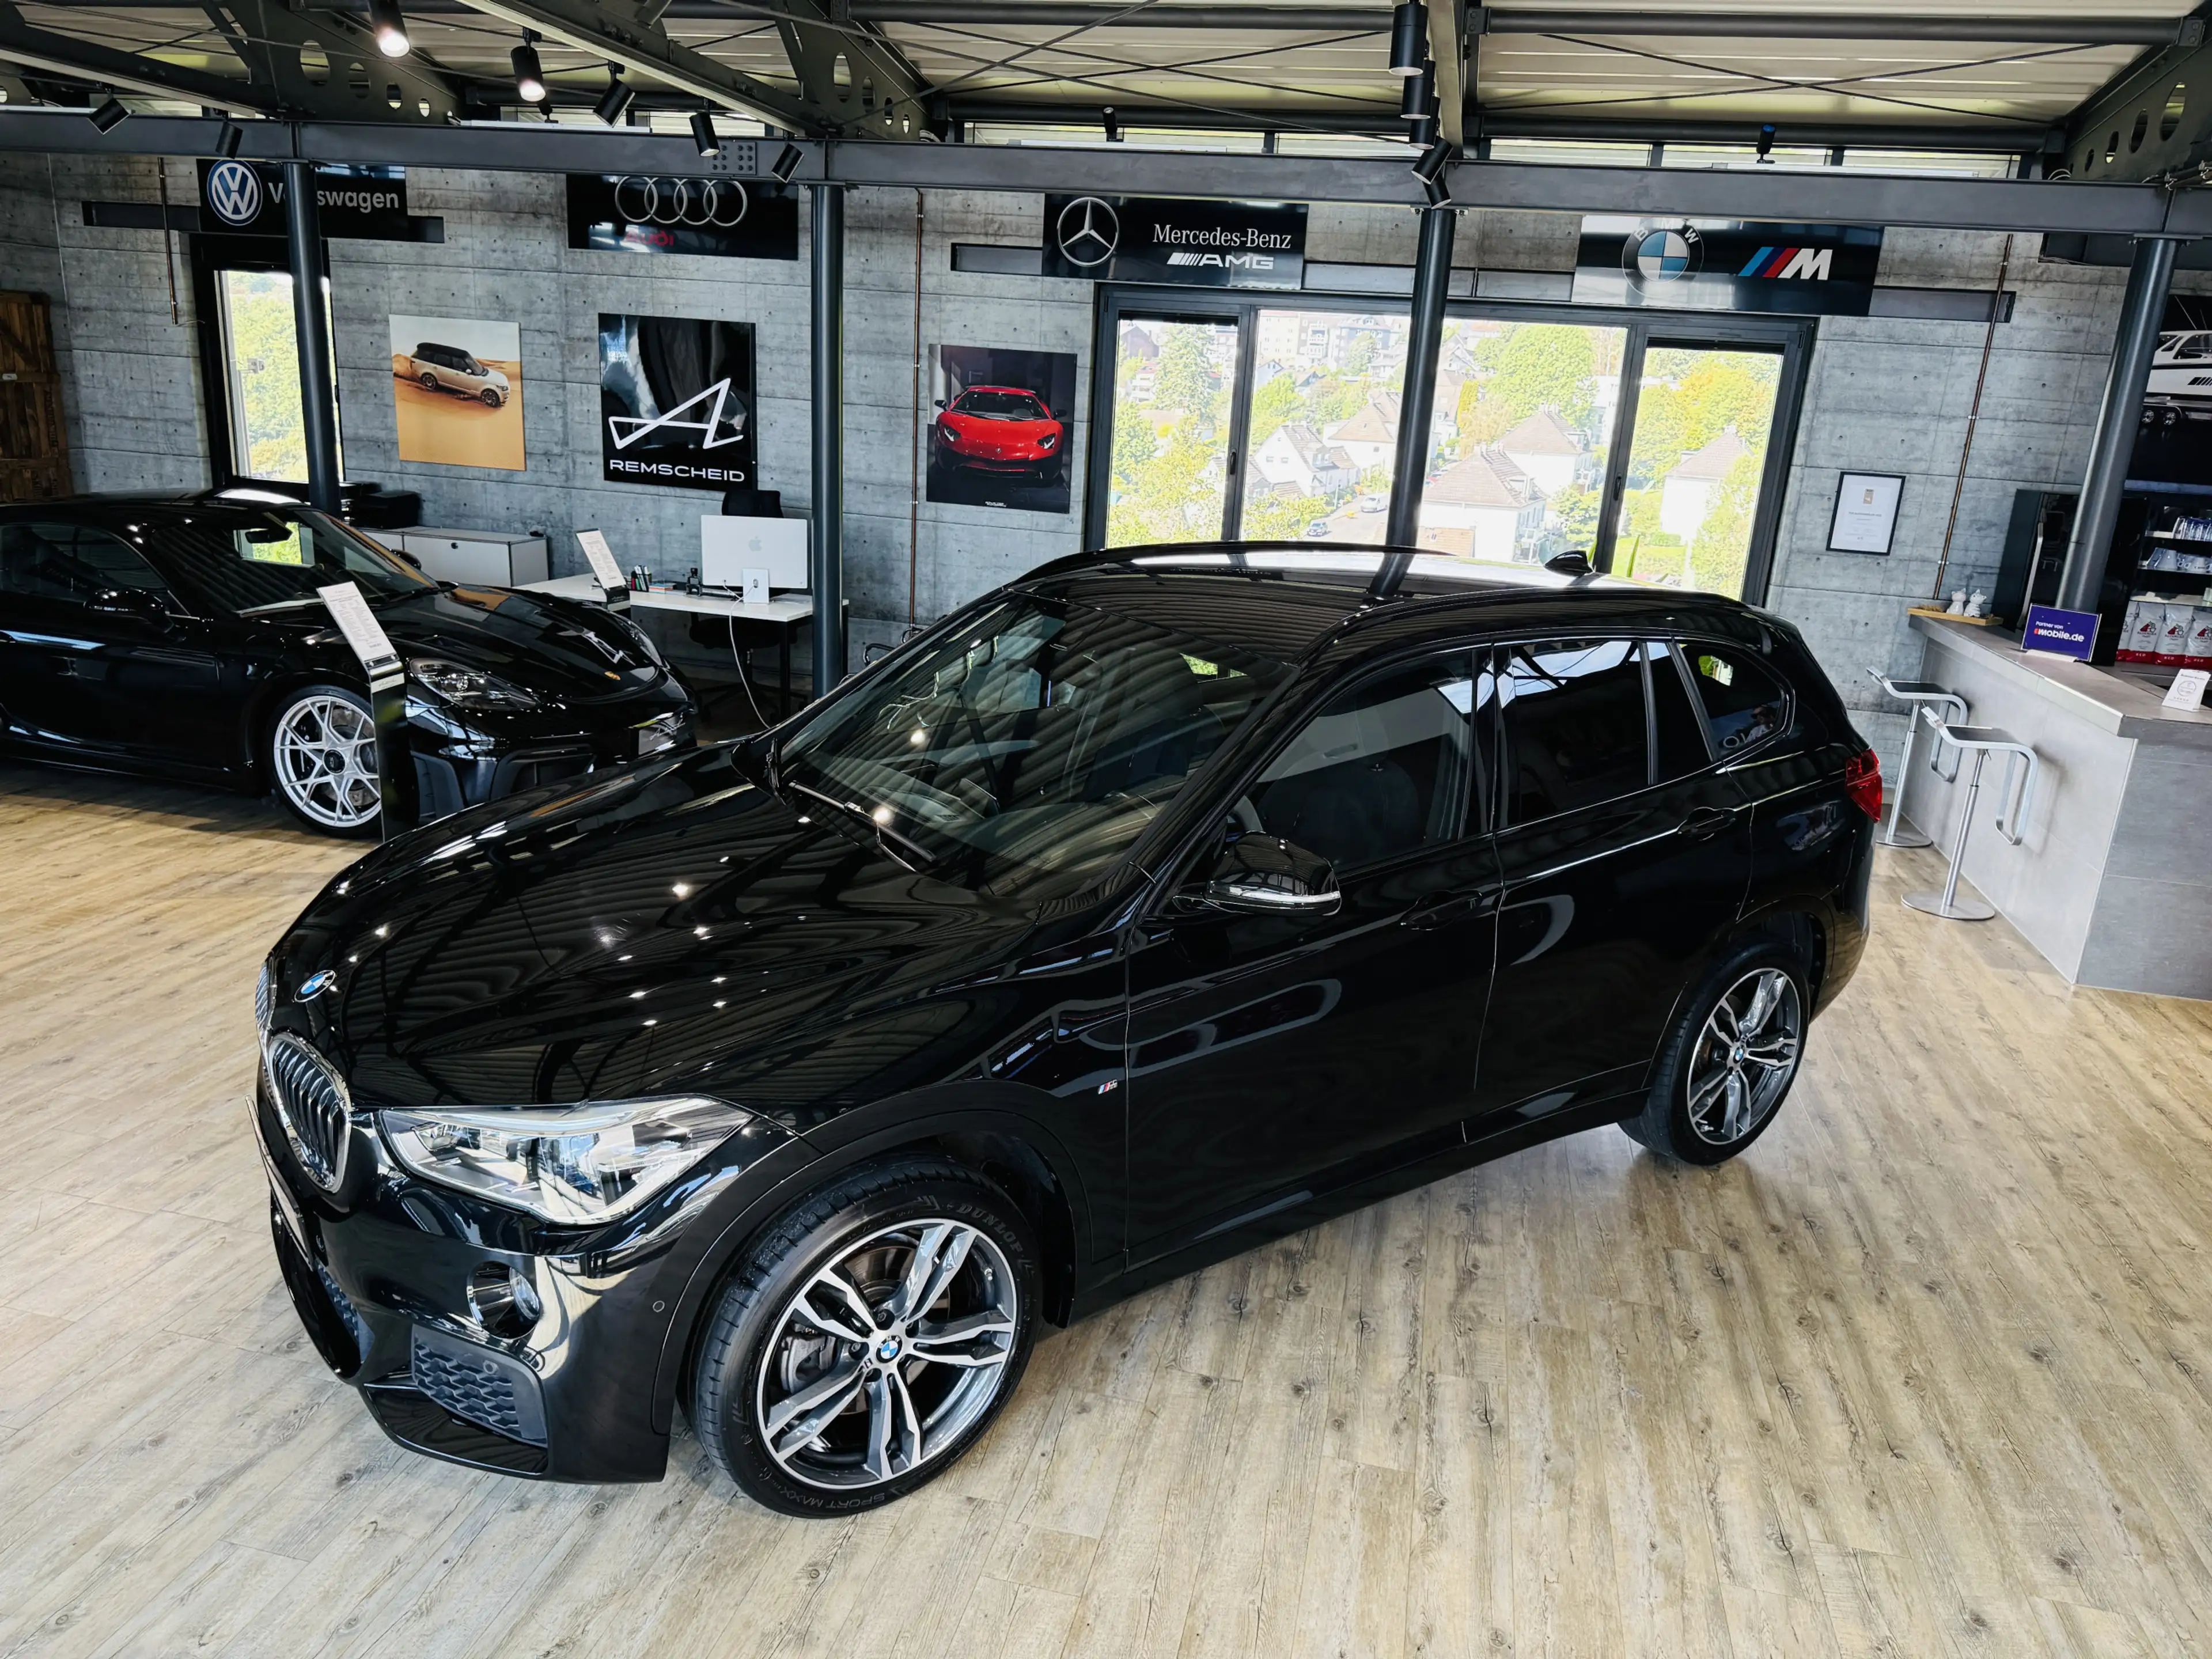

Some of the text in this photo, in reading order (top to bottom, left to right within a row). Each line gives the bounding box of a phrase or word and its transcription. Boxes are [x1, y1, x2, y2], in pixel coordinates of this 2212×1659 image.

[268, 182, 399, 213] Vswagen
[1153, 224, 1292, 249] Mercedes-Benz
[1198, 254, 1274, 270] AMG
[1778, 248, 1834, 281] M
[609, 459, 745, 482] REMSCHEID
[2037, 628, 2085, 642] mobile.de
[956, 1203, 1023, 1252] DUNLOP
[779, 1486, 885, 1509] SPORT MAXX
